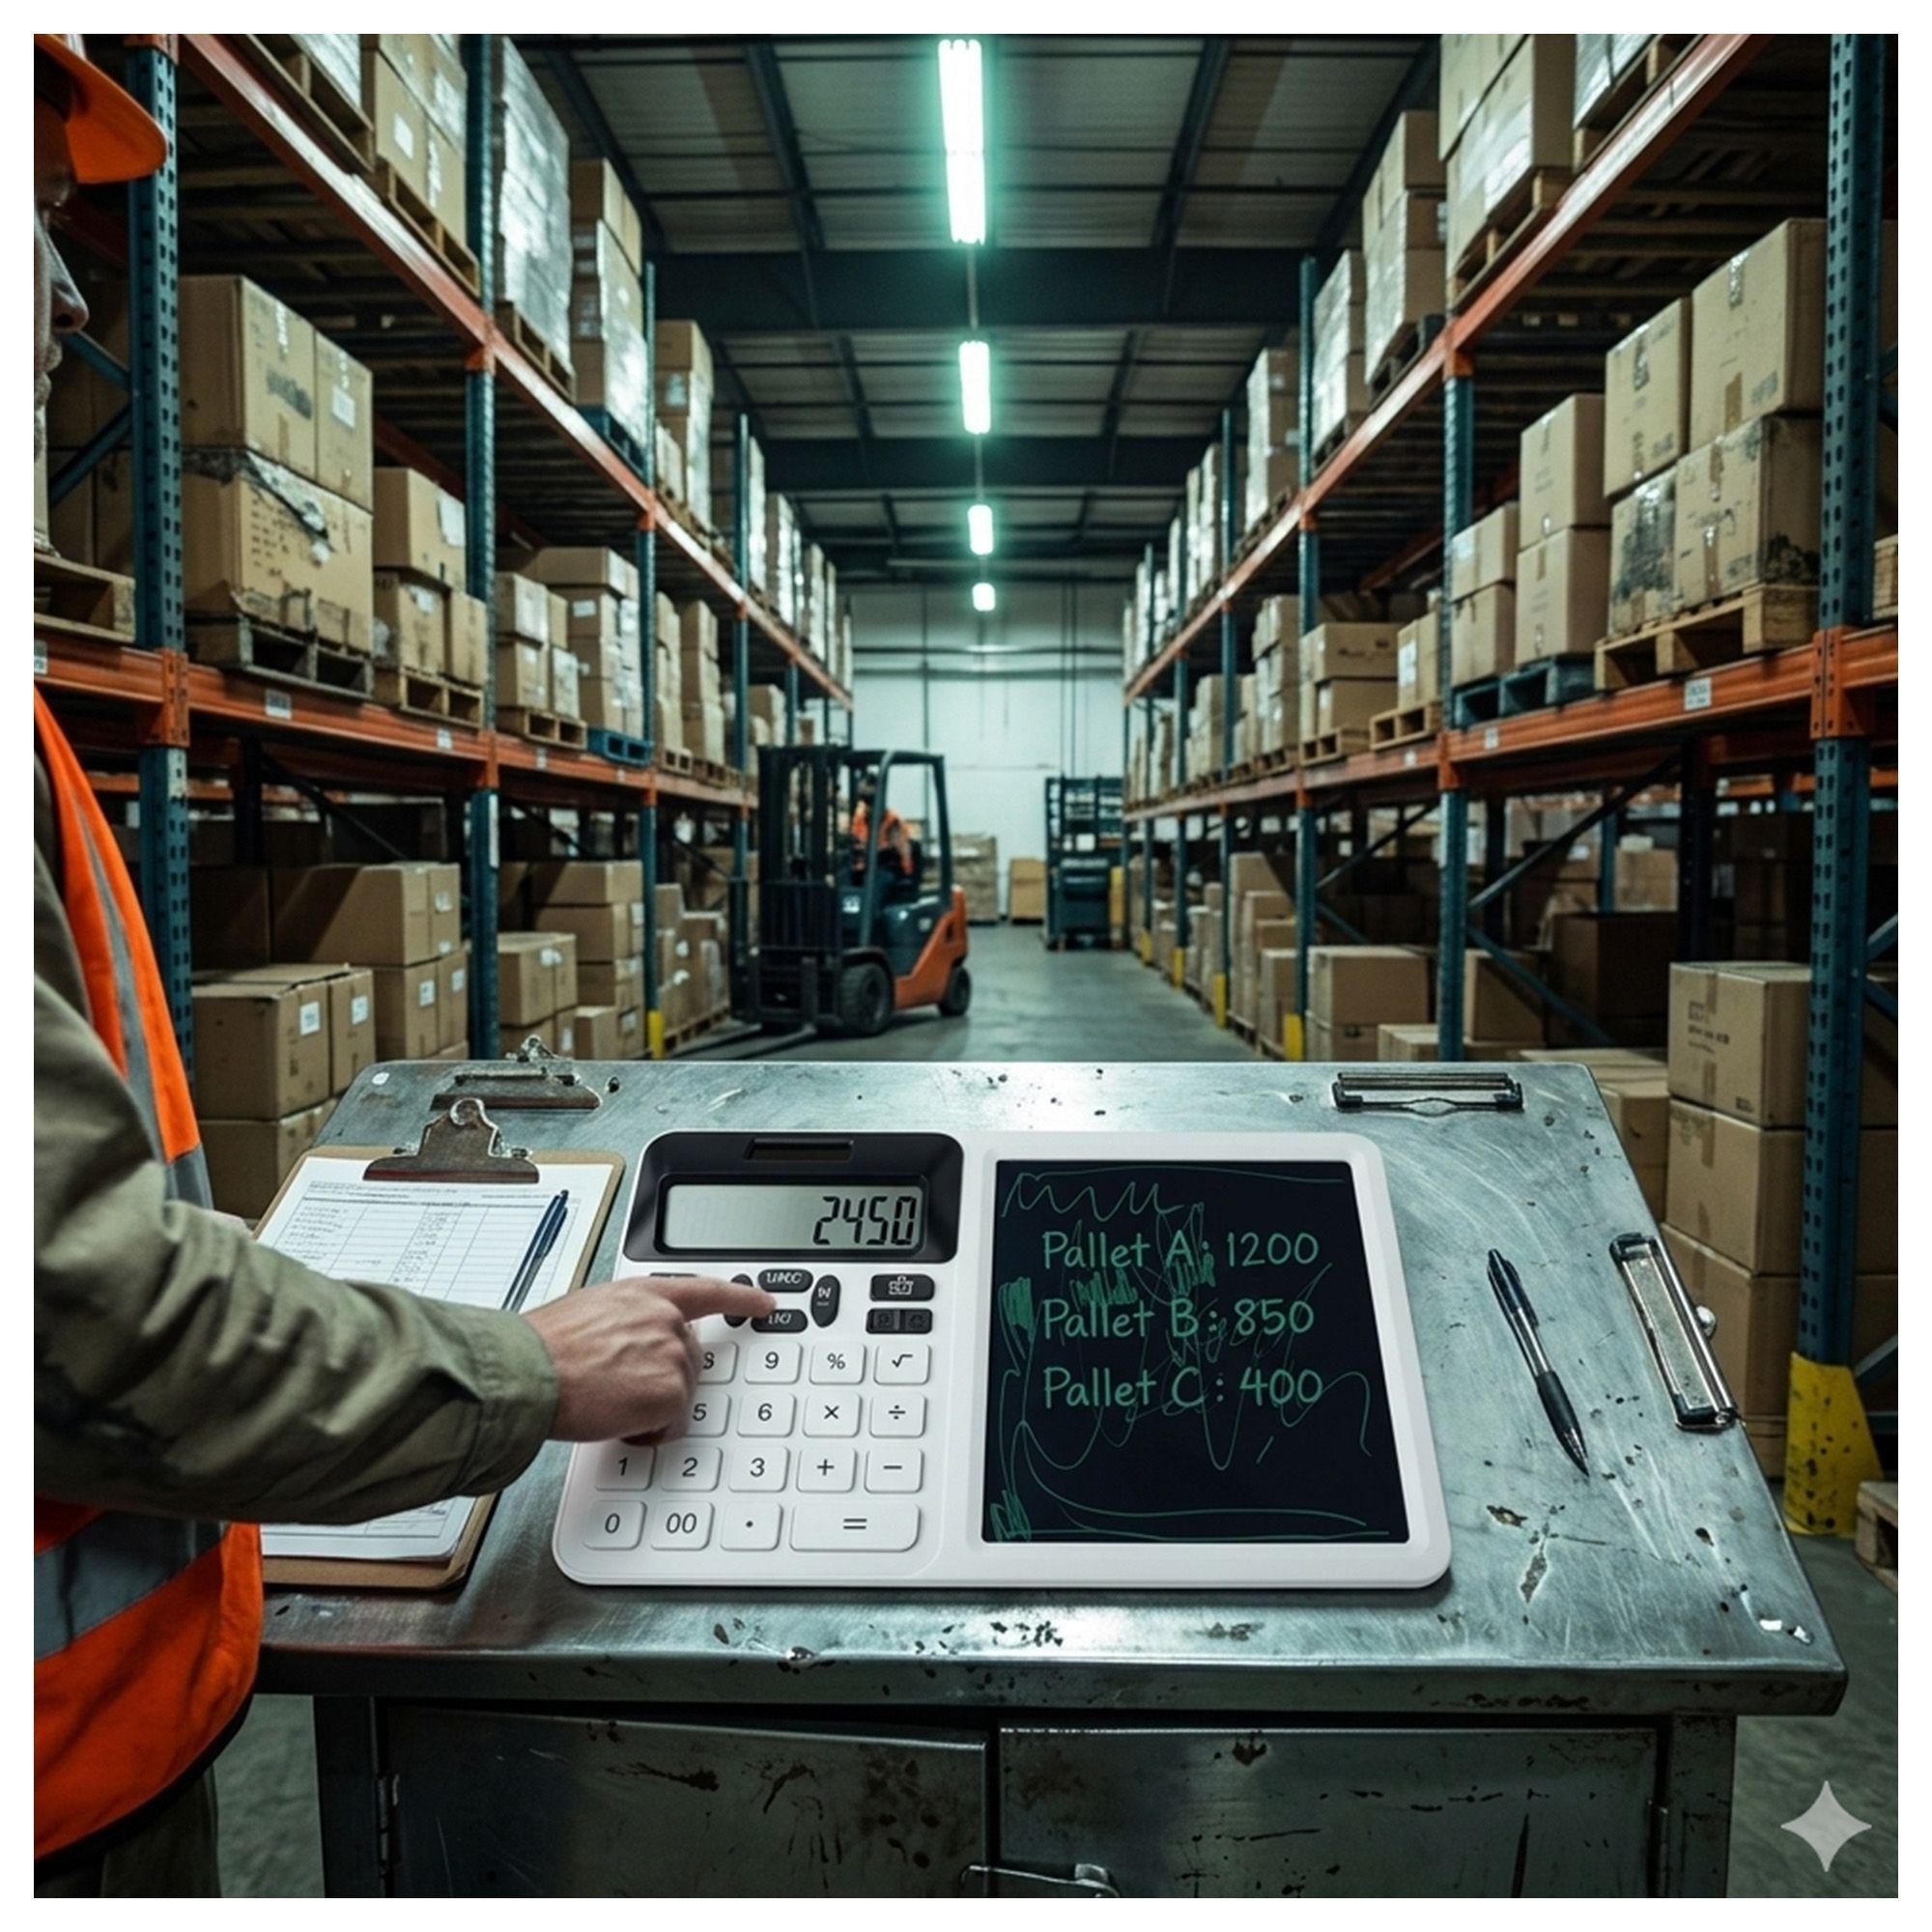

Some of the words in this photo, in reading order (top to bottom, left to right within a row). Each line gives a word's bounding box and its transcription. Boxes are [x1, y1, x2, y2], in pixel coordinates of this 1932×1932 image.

[812, 1196, 917, 1245] 2450
[1042, 1231, 1151, 1269] Pallet
[1227, 1232, 1320, 1266] 1200
[1043, 1298, 1154, 1340] Pallet
[1234, 1298, 1315, 1336] 850
[765, 1351, 780, 1370] 9
[826, 1353, 846, 1371] %
[1043, 1366, 1157, 1409] Pallet
[1239, 1367, 1323, 1406] 400
[693, 1403, 707, 1421] 5
[757, 1403, 773, 1422] 6
[617, 1456, 629, 1477] 1
[681, 1457, 698, 1477] 2
[750, 1457, 766, 1477] 3
[604, 1513, 621, 1534] 0
[666, 1513, 697, 1534] 00
